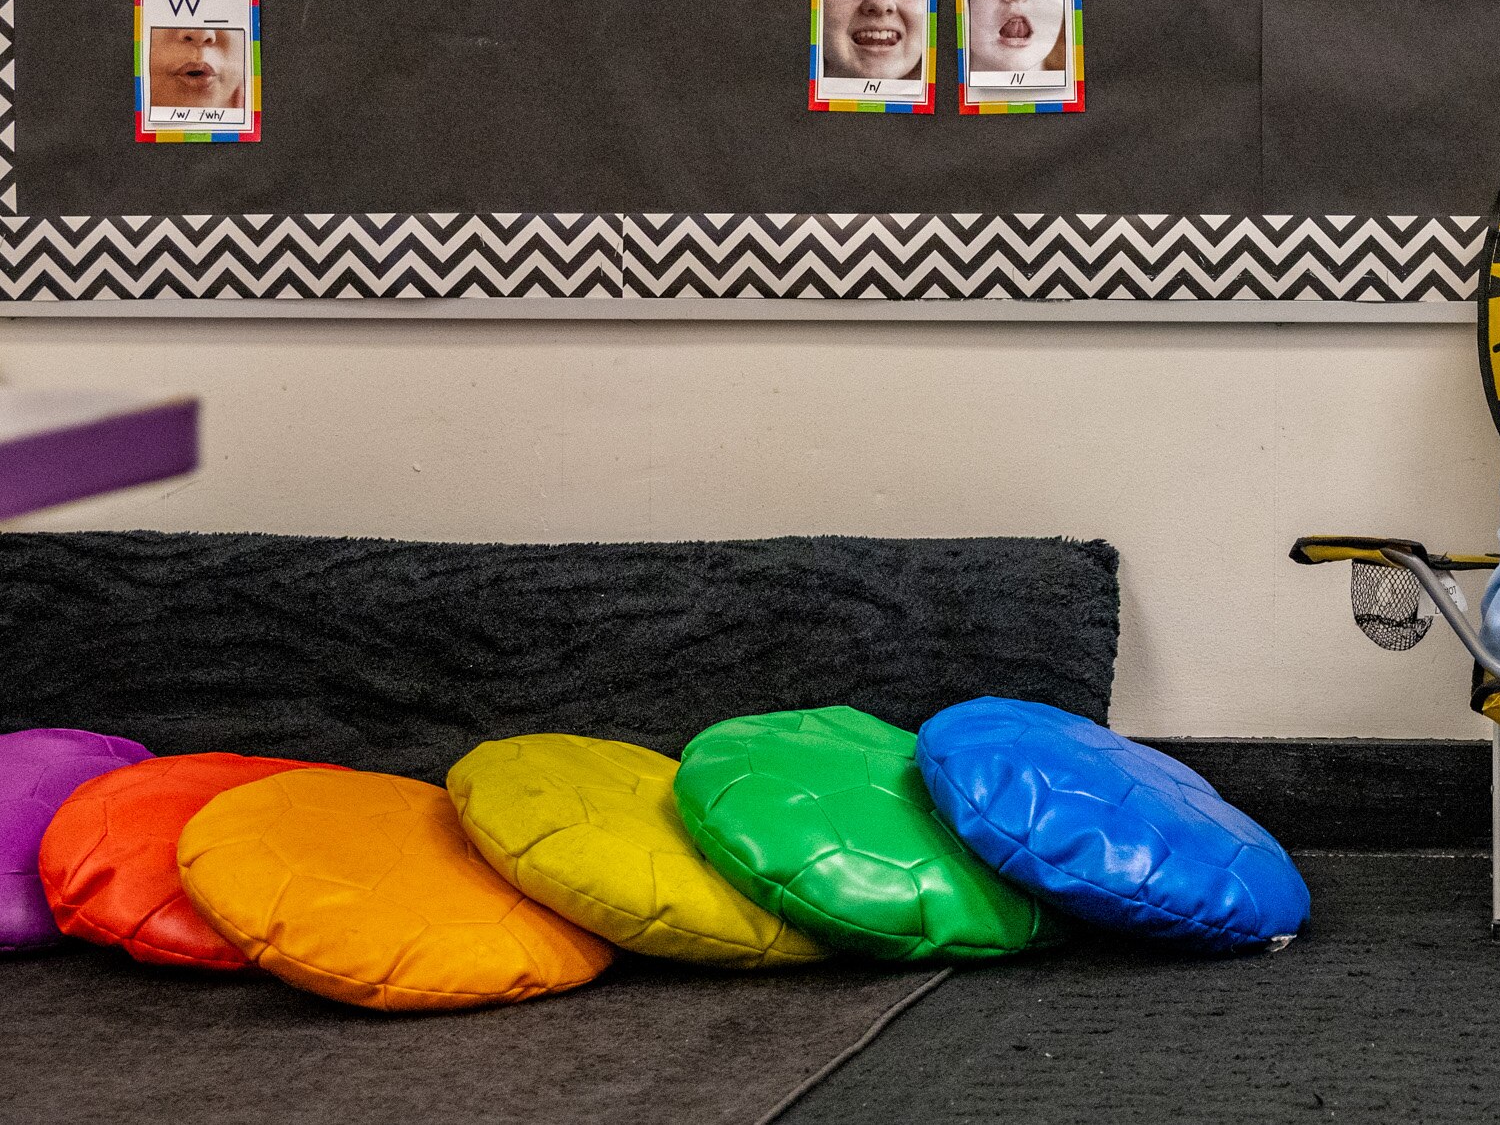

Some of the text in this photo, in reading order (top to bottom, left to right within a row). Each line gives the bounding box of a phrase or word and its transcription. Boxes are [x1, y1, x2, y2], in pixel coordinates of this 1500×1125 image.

[1011, 73, 1024, 85] /l/
[864, 81, 881, 93] /n/
[171, 109, 224, 121] /w/ /wh/
